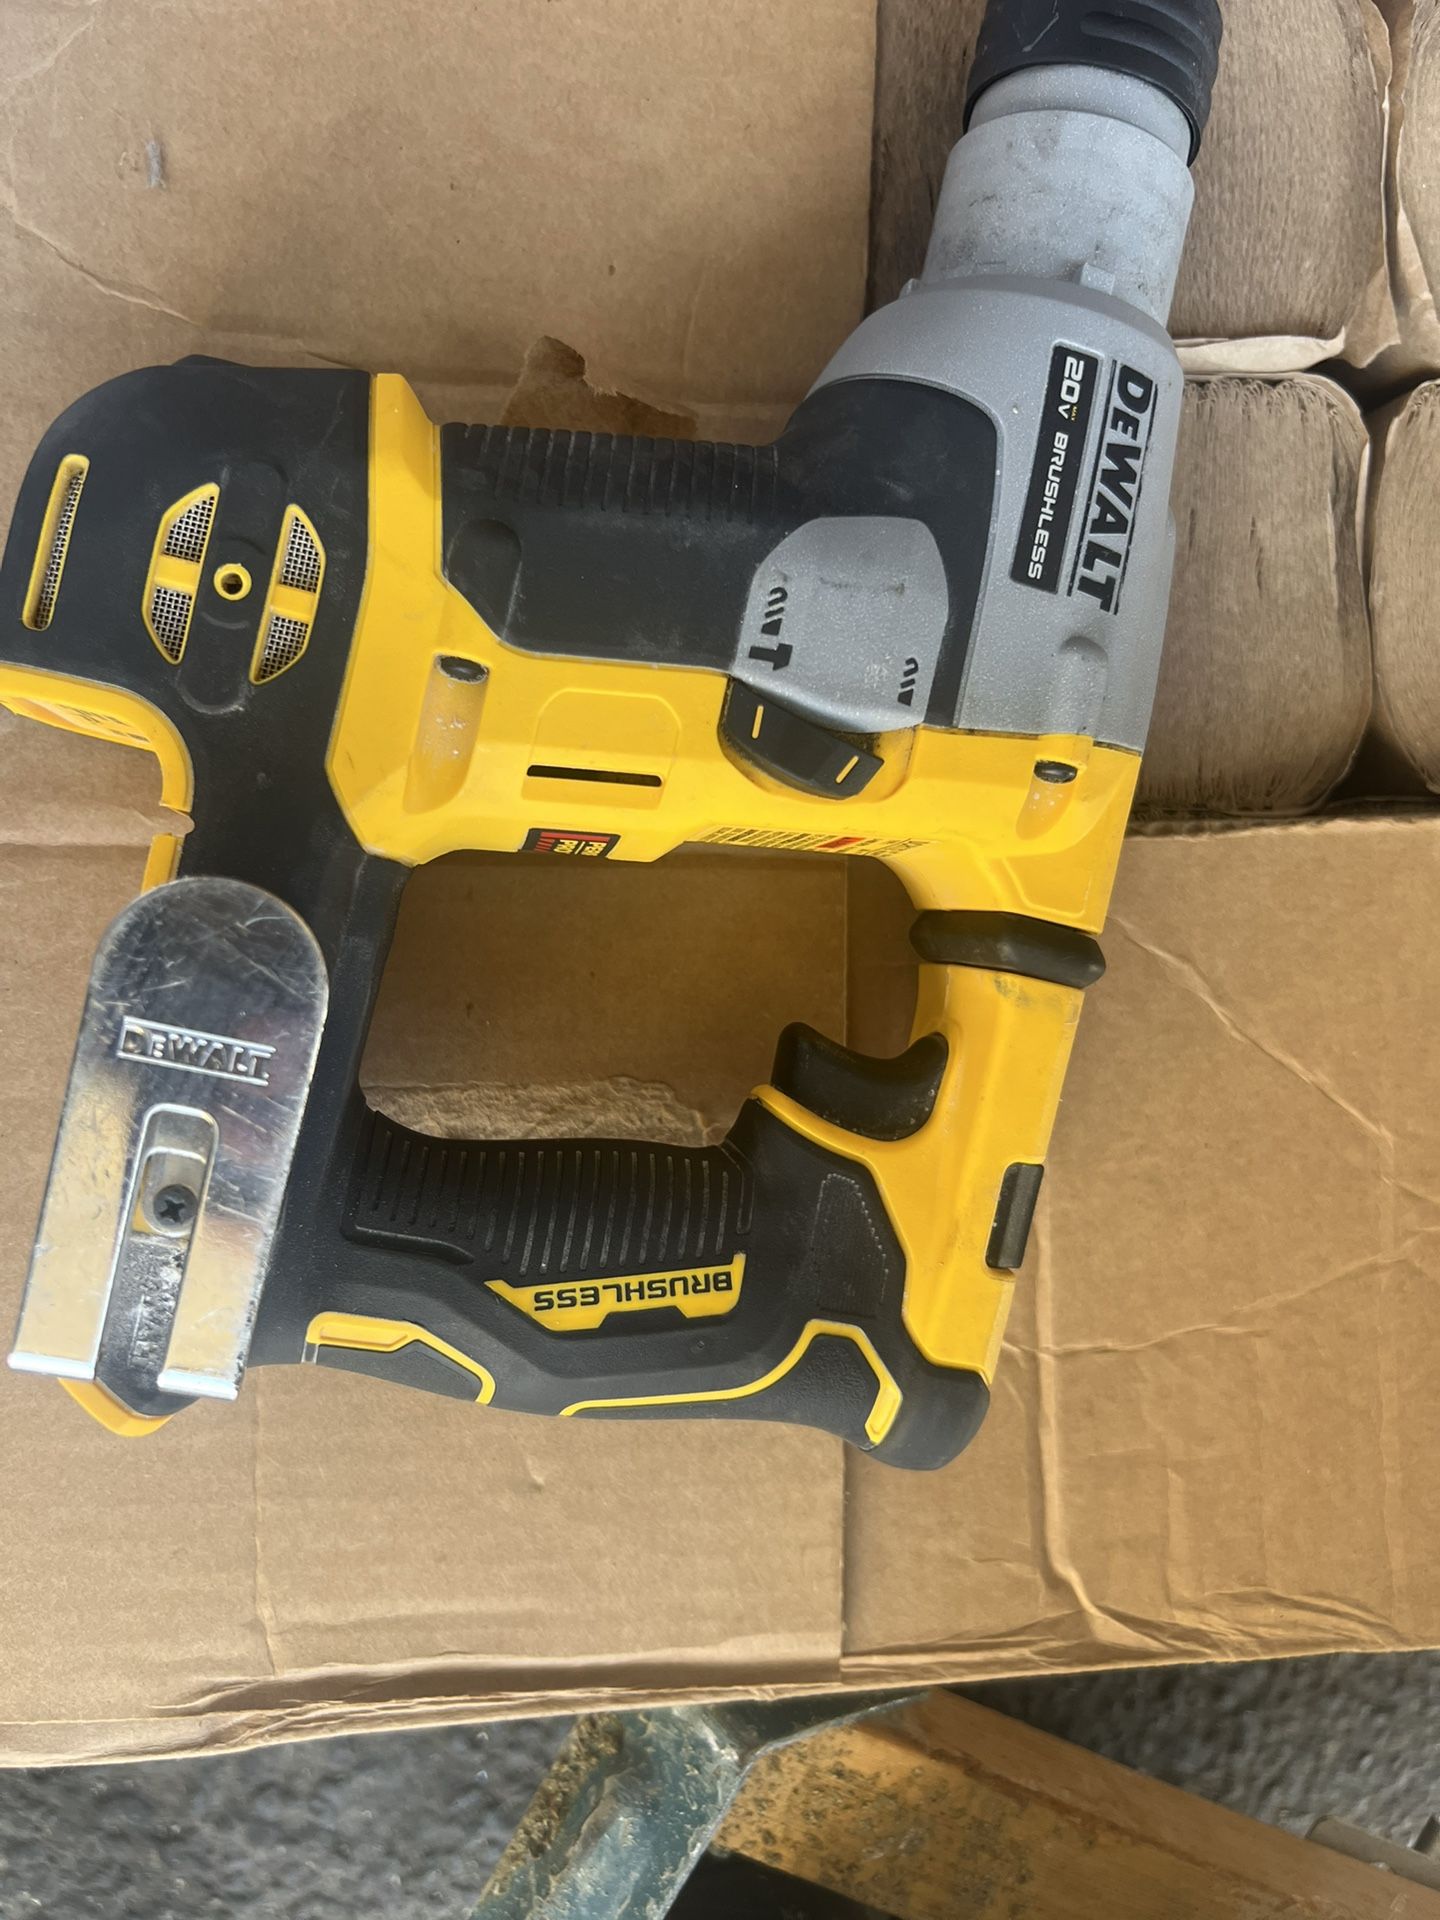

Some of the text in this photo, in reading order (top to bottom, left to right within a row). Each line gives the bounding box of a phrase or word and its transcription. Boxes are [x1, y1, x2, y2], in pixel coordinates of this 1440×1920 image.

[1027, 431, 1069, 580] BRUSHLESS
[1076, 364, 1154, 613] DEWALT
[533, 1271, 733, 1312] BRUSHLESS
